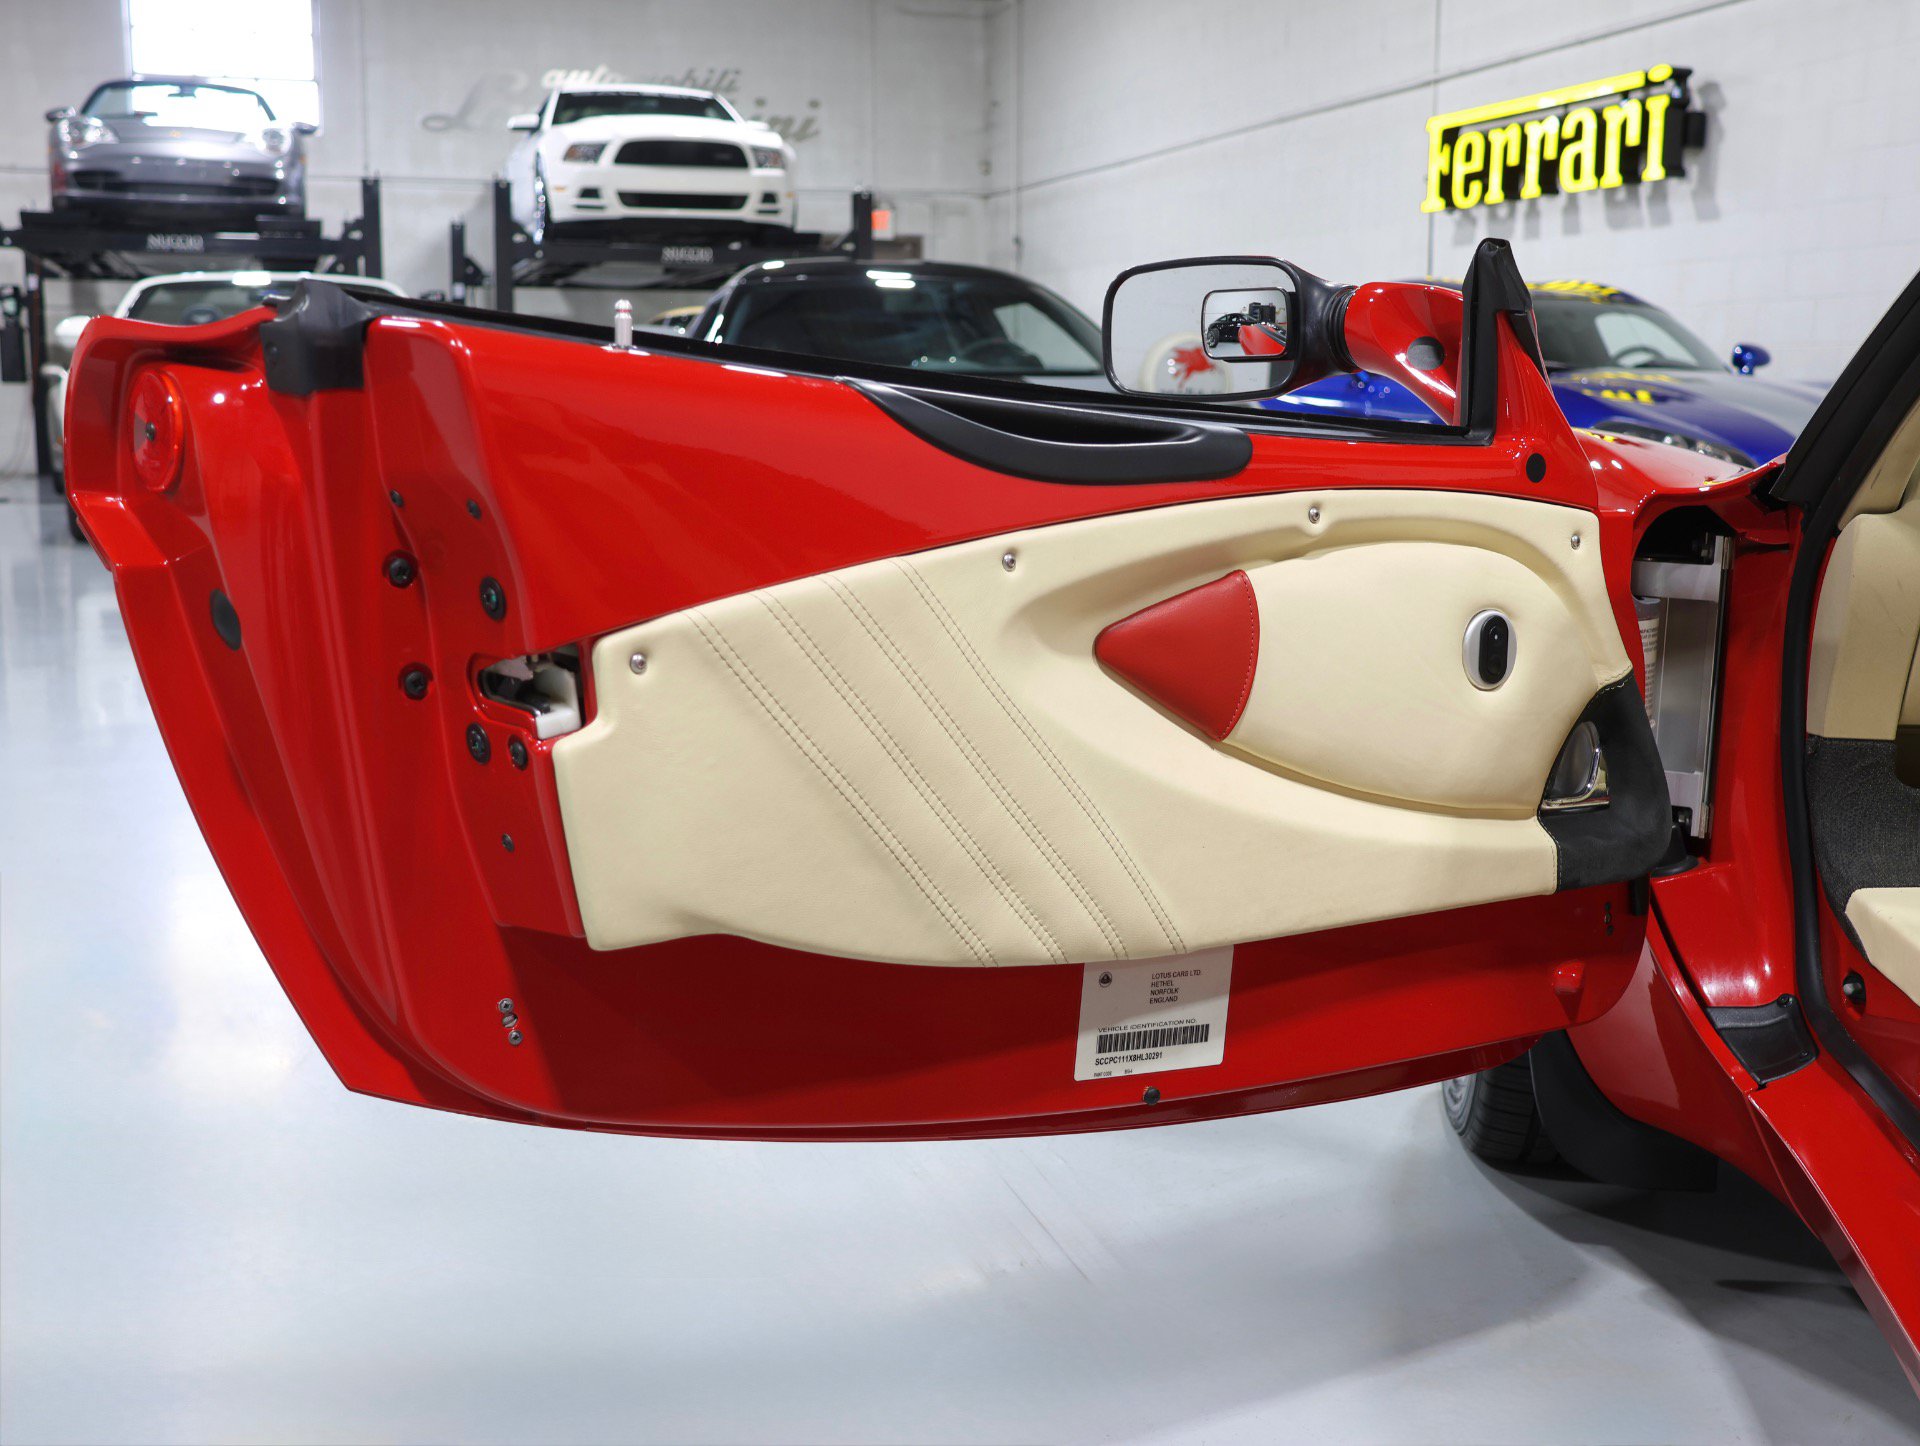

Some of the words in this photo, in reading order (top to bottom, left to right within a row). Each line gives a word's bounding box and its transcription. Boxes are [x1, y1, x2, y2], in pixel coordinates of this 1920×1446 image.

[1420, 63, 1674, 214] Ferrari
[1152, 971, 1172, 979] LOTUS
[1172, 970, 1189, 978] CARS
[1151, 980, 1173, 988] HETHEL
[1150, 988, 1179, 996] NORFOLK
[1150, 996, 1178, 1004] ENGLAND
[1098, 1025, 1129, 1033] VEHICLE
[1130, 1020, 1185, 1030] IDENTIFICATION
